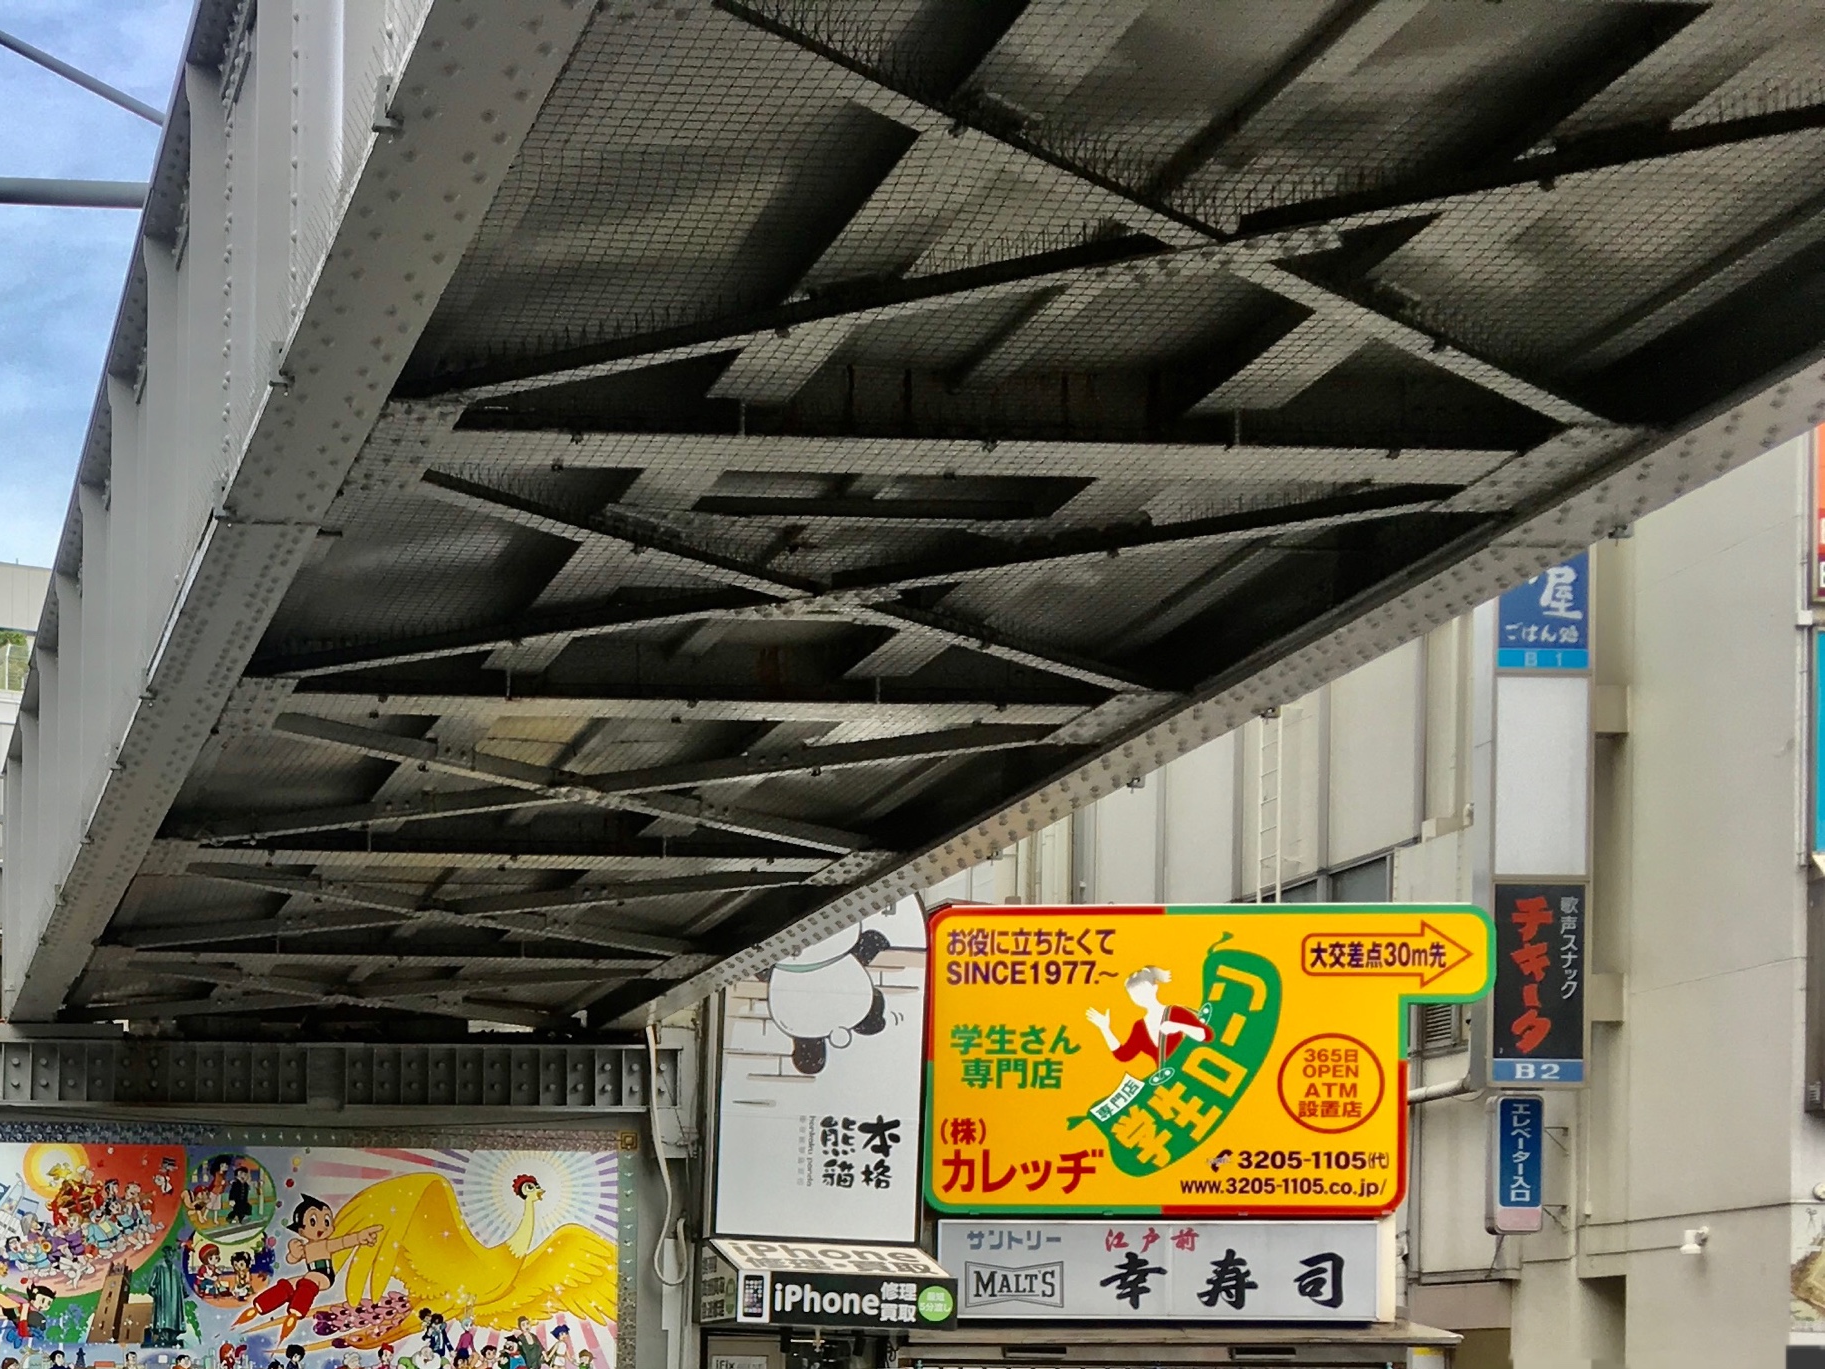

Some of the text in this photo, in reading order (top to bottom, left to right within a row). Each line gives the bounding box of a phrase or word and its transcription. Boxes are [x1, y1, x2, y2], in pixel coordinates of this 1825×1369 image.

[1505, 623, 1579, 643] ごはん処
[946, 928, 1116, 957] お役に立ちたくて
[1560, 896, 1580, 1000] 歌声スナック
[1310, 942, 1447, 970] 大交差点30m先
[951, 1024, 1080, 1057] 学生さん
[1303, 1047, 1359, 1063] 365日
[961, 1058, 1063, 1090] 専門店
[1112, 964, 1268, 1173] 学生ローン
[1302, 1064, 1359, 1079] OPEN
[1514, 1063, 1560, 1080] B2
[1095, 1078, 1140, 1122] 専門店
[1304, 1081, 1358, 1098] ATM
[1297, 1100, 1362, 1118] 設置店
[1511, 1103, 1531, 1202] エレベーター入口
[1181, 1176, 1387, 1198] www.3205-1105.co.jp/
[728, 1242, 919, 1264] iPhone
[967, 1230, 1062, 1251] サントリー
[1105, 1227, 1200, 1253] 江戸前
[880, 1281, 917, 1301] 修理
[974, 1269, 1056, 1298] MALT'S
[1100, 1249, 1346, 1309] 幸寿司
[774, 1282, 880, 1316] iPhone
[880, 1303, 917, 1323] 買取
